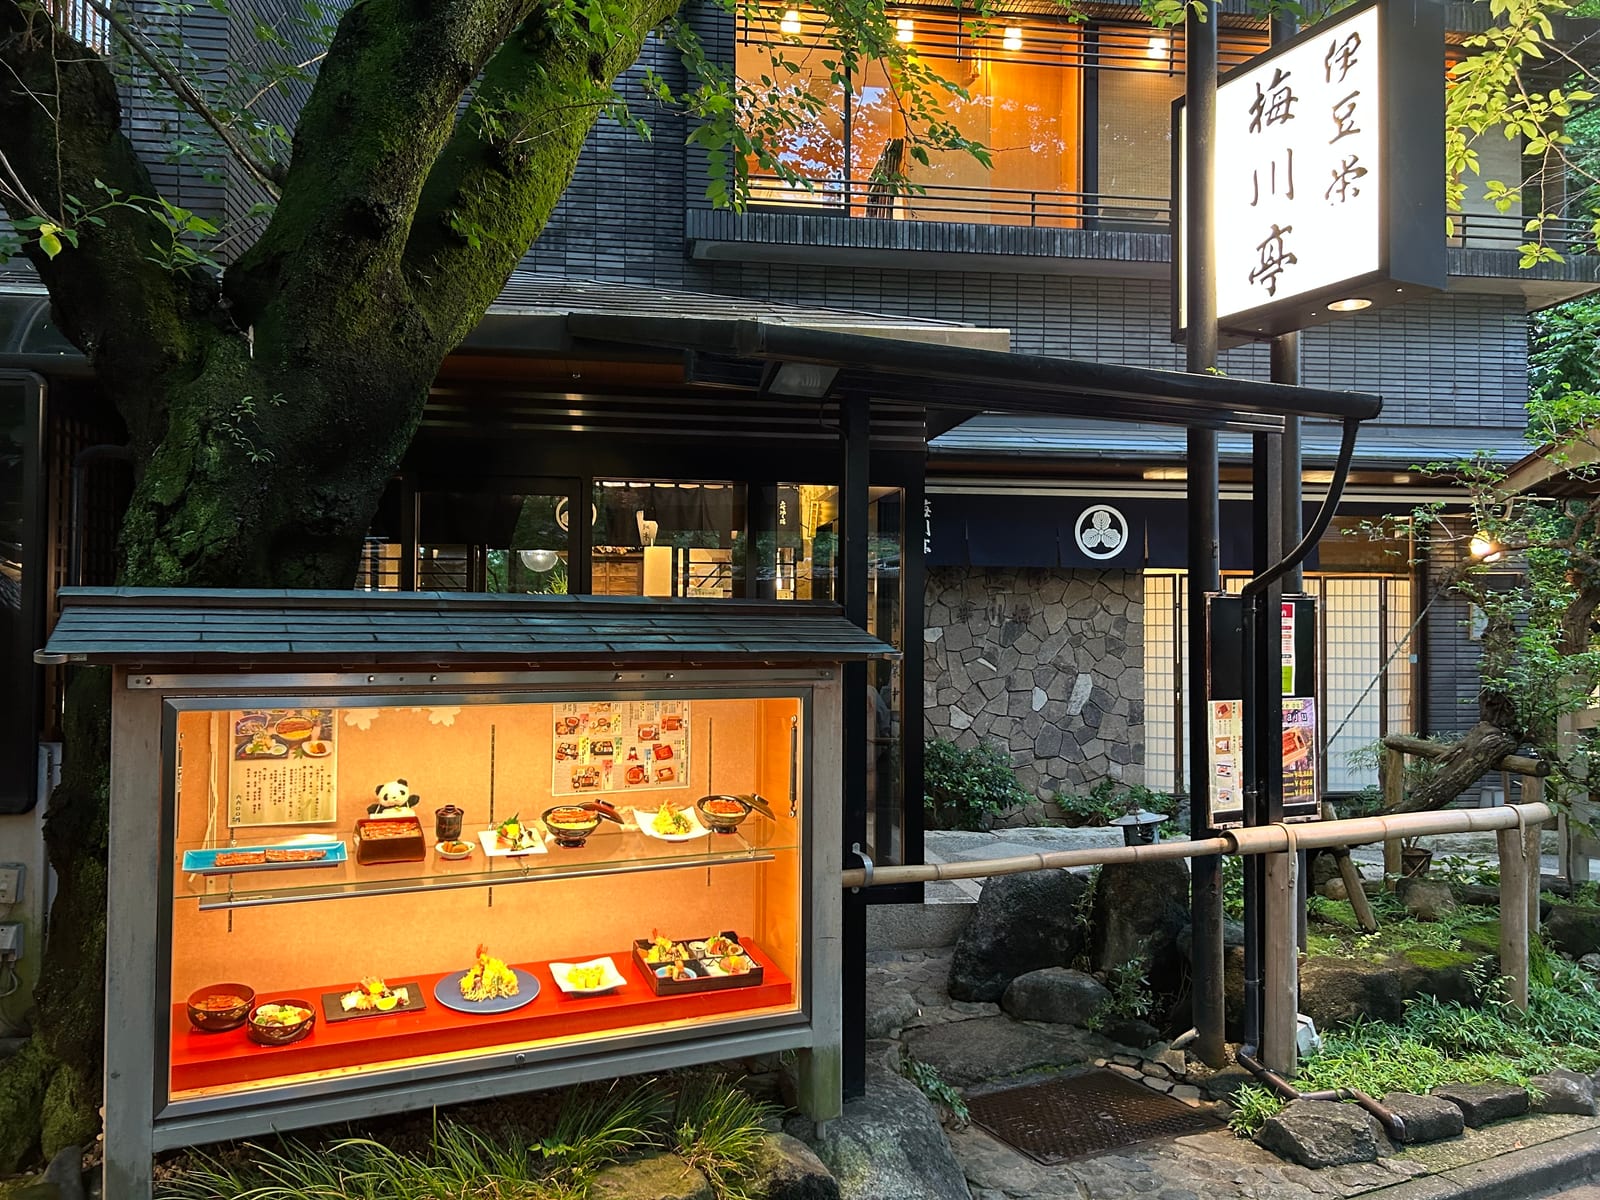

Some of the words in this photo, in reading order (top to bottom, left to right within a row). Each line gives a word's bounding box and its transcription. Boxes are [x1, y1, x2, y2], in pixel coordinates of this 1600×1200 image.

[1248, 67, 1299, 297] 梅川亭
[1323, 31, 1368, 206] 伊豆栄
